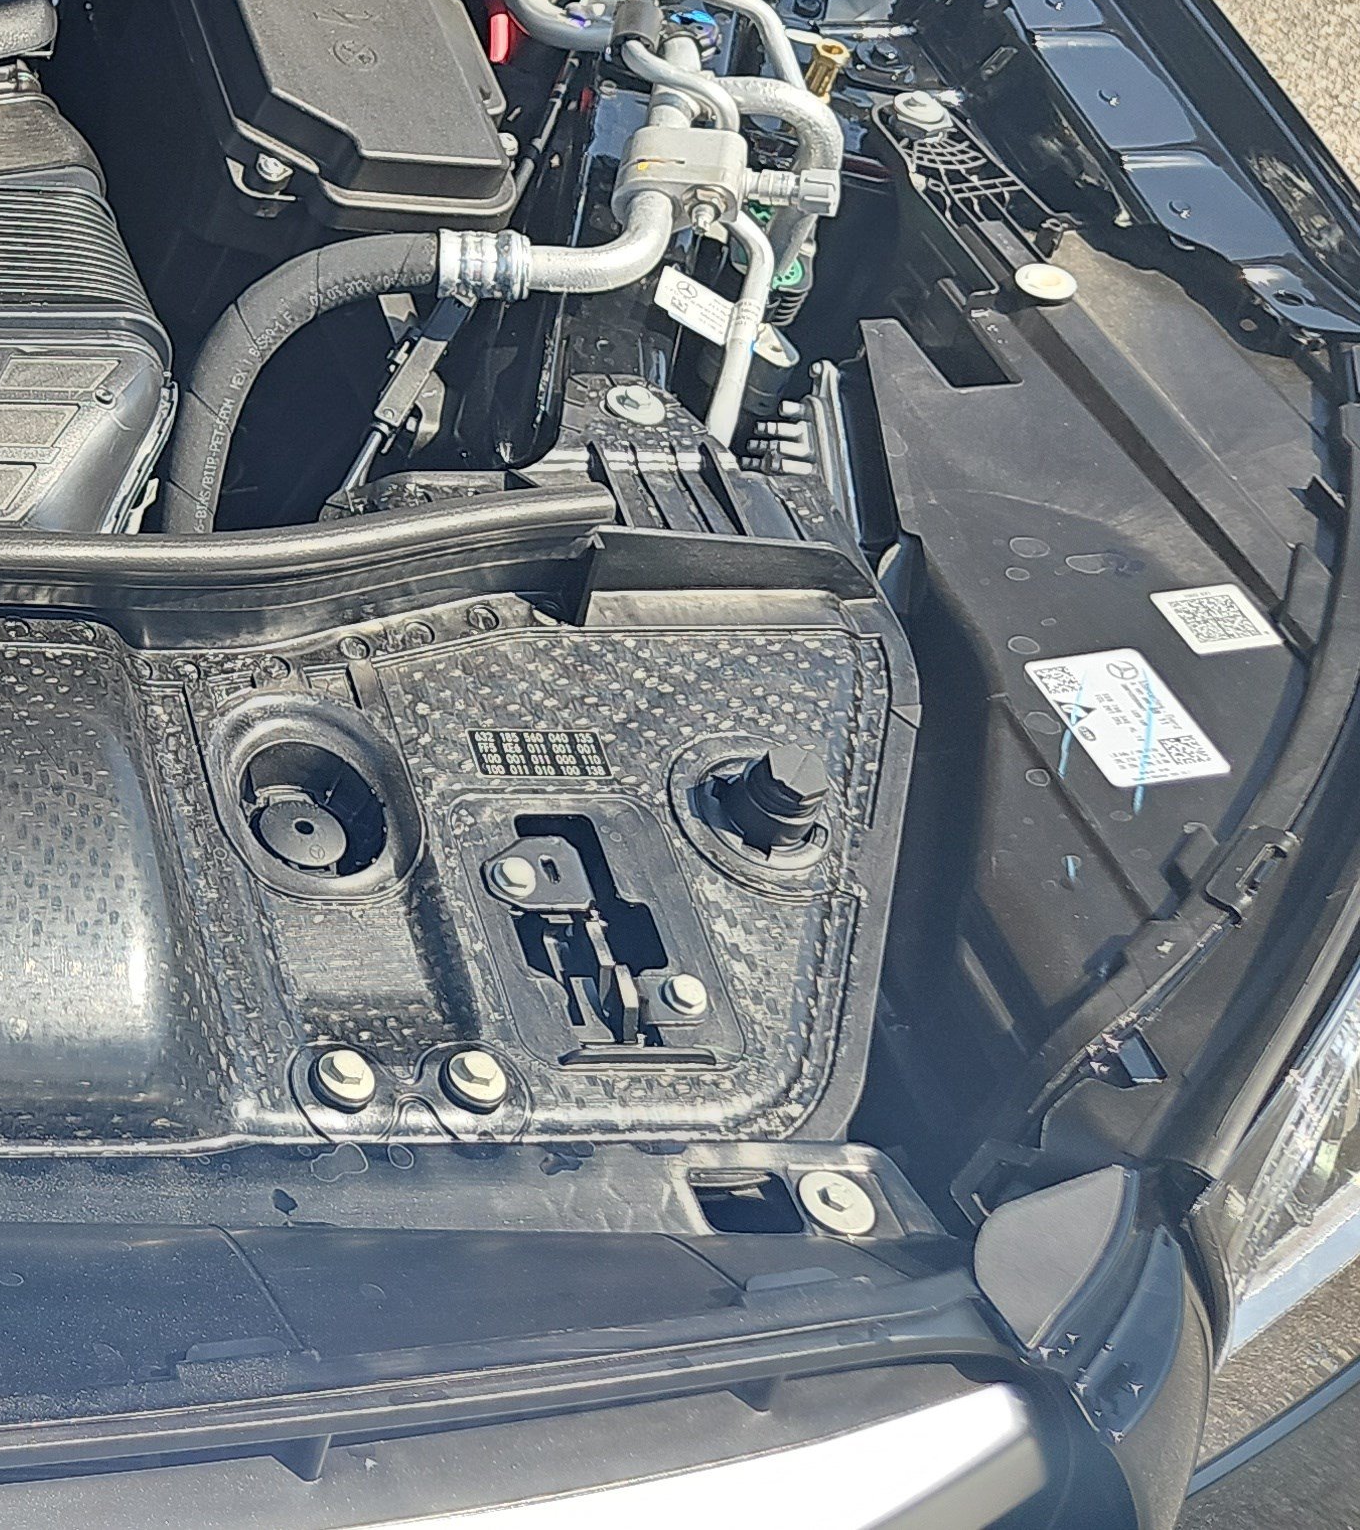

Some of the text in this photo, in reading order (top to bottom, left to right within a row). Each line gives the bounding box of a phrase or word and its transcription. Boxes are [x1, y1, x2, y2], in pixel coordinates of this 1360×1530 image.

[526, 743, 547, 754] 011
[551, 743, 572, 754] 001
[576, 743, 597, 754] 001
[482, 753, 601, 765] 100 001 011 000 110
[485, 764, 506, 775] 100
[509, 764, 530, 775] 011
[533, 764, 555, 776] 010
[560, 765, 580, 776] 100
